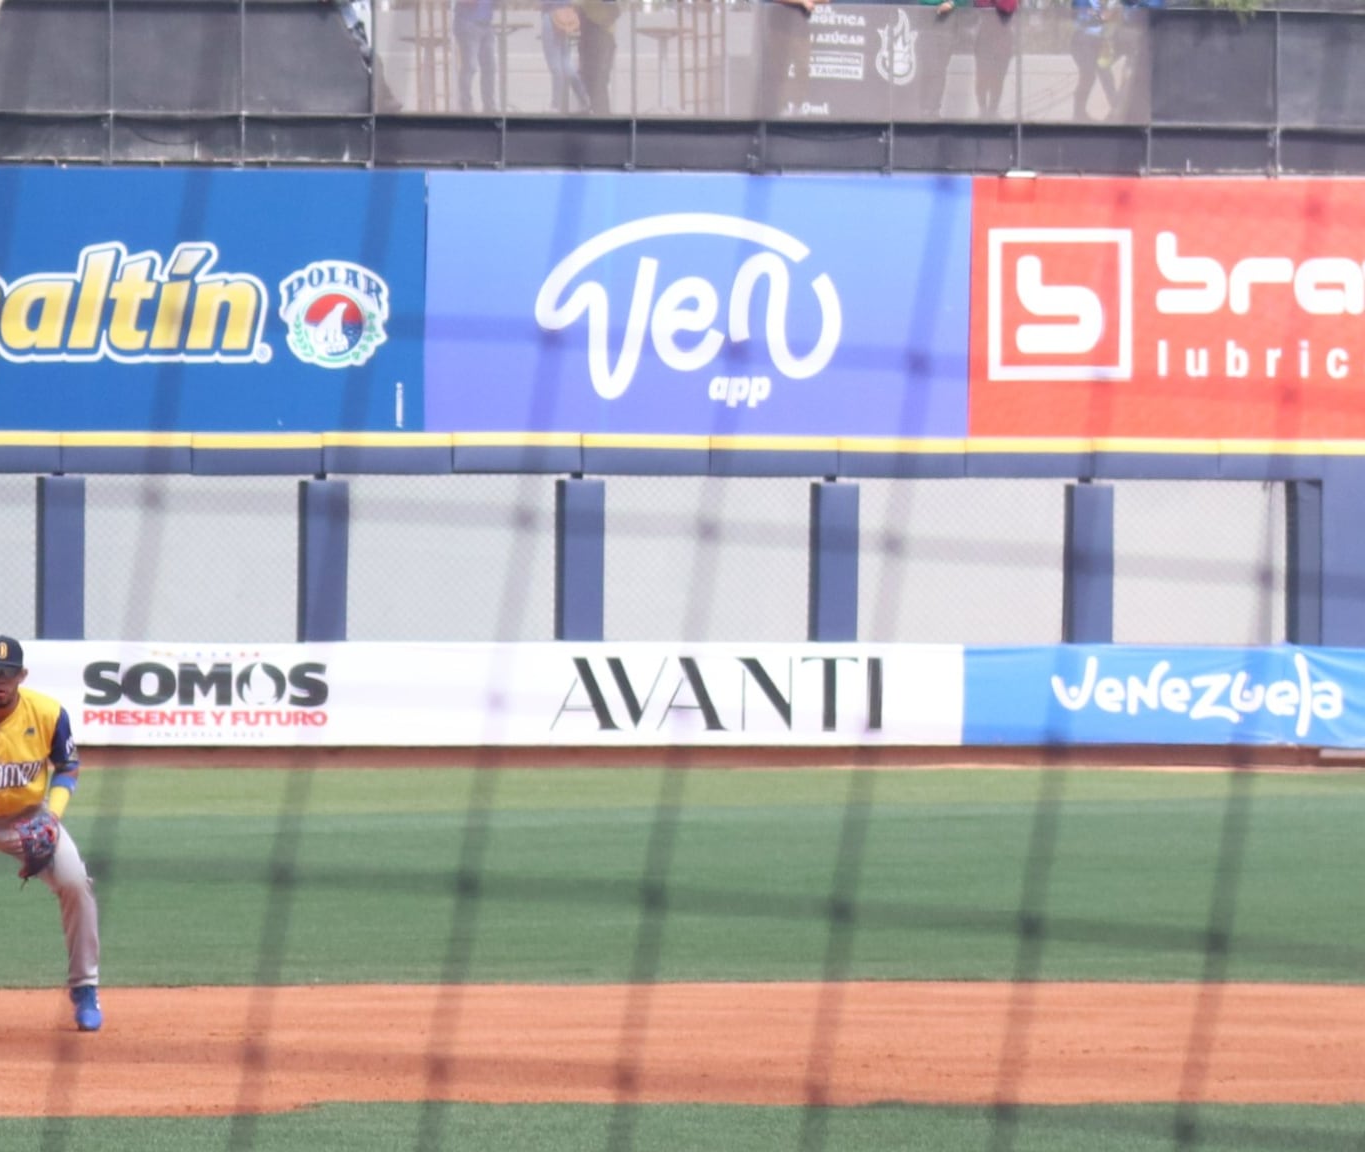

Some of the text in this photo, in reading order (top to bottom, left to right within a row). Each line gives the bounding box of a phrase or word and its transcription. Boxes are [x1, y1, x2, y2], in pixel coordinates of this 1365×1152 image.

[284, 266, 384, 312] POLAR
[708, 376, 772, 407] app
[82, 661, 329, 708] SOMOS
[549, 656, 883, 732] AVANTI
[1051, 652, 1344, 738] Venezuela
[82, 710, 328, 727] PRESENTE Y FUTURO
